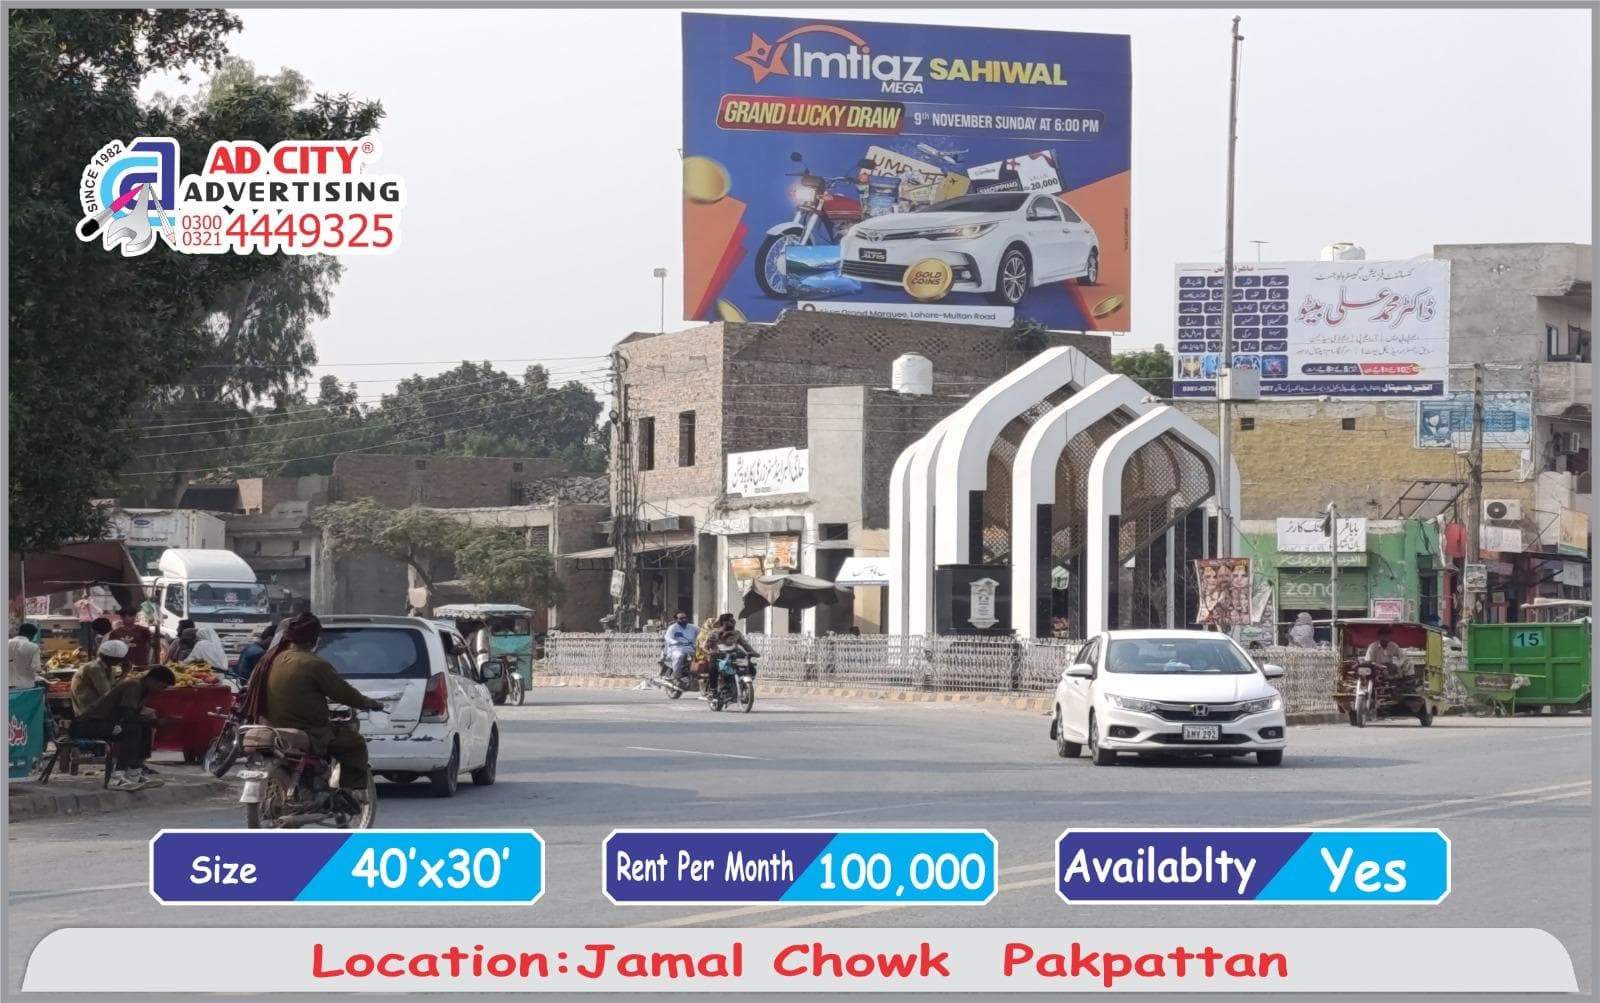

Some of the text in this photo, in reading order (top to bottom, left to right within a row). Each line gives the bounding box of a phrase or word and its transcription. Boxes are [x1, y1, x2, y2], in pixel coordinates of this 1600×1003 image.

[794, 42, 1067, 85] Imtiaz SAHIWAL
[881, 82, 924, 94] MEGA
[724, 101, 901, 129] GRAND LUCKY DRAW
[914, 112, 1099, 133] 9th NOVEMBER SUNDAY AT 6:00 PM
[1031, 177, 1058, 191] 20,000
[1325, 287, 1391, 326] علی
[1369, 295, 1399, 320] محمد
[1390, 287, 1435, 328] ڈاکٹر
[1517, 633, 1539, 646] 15
